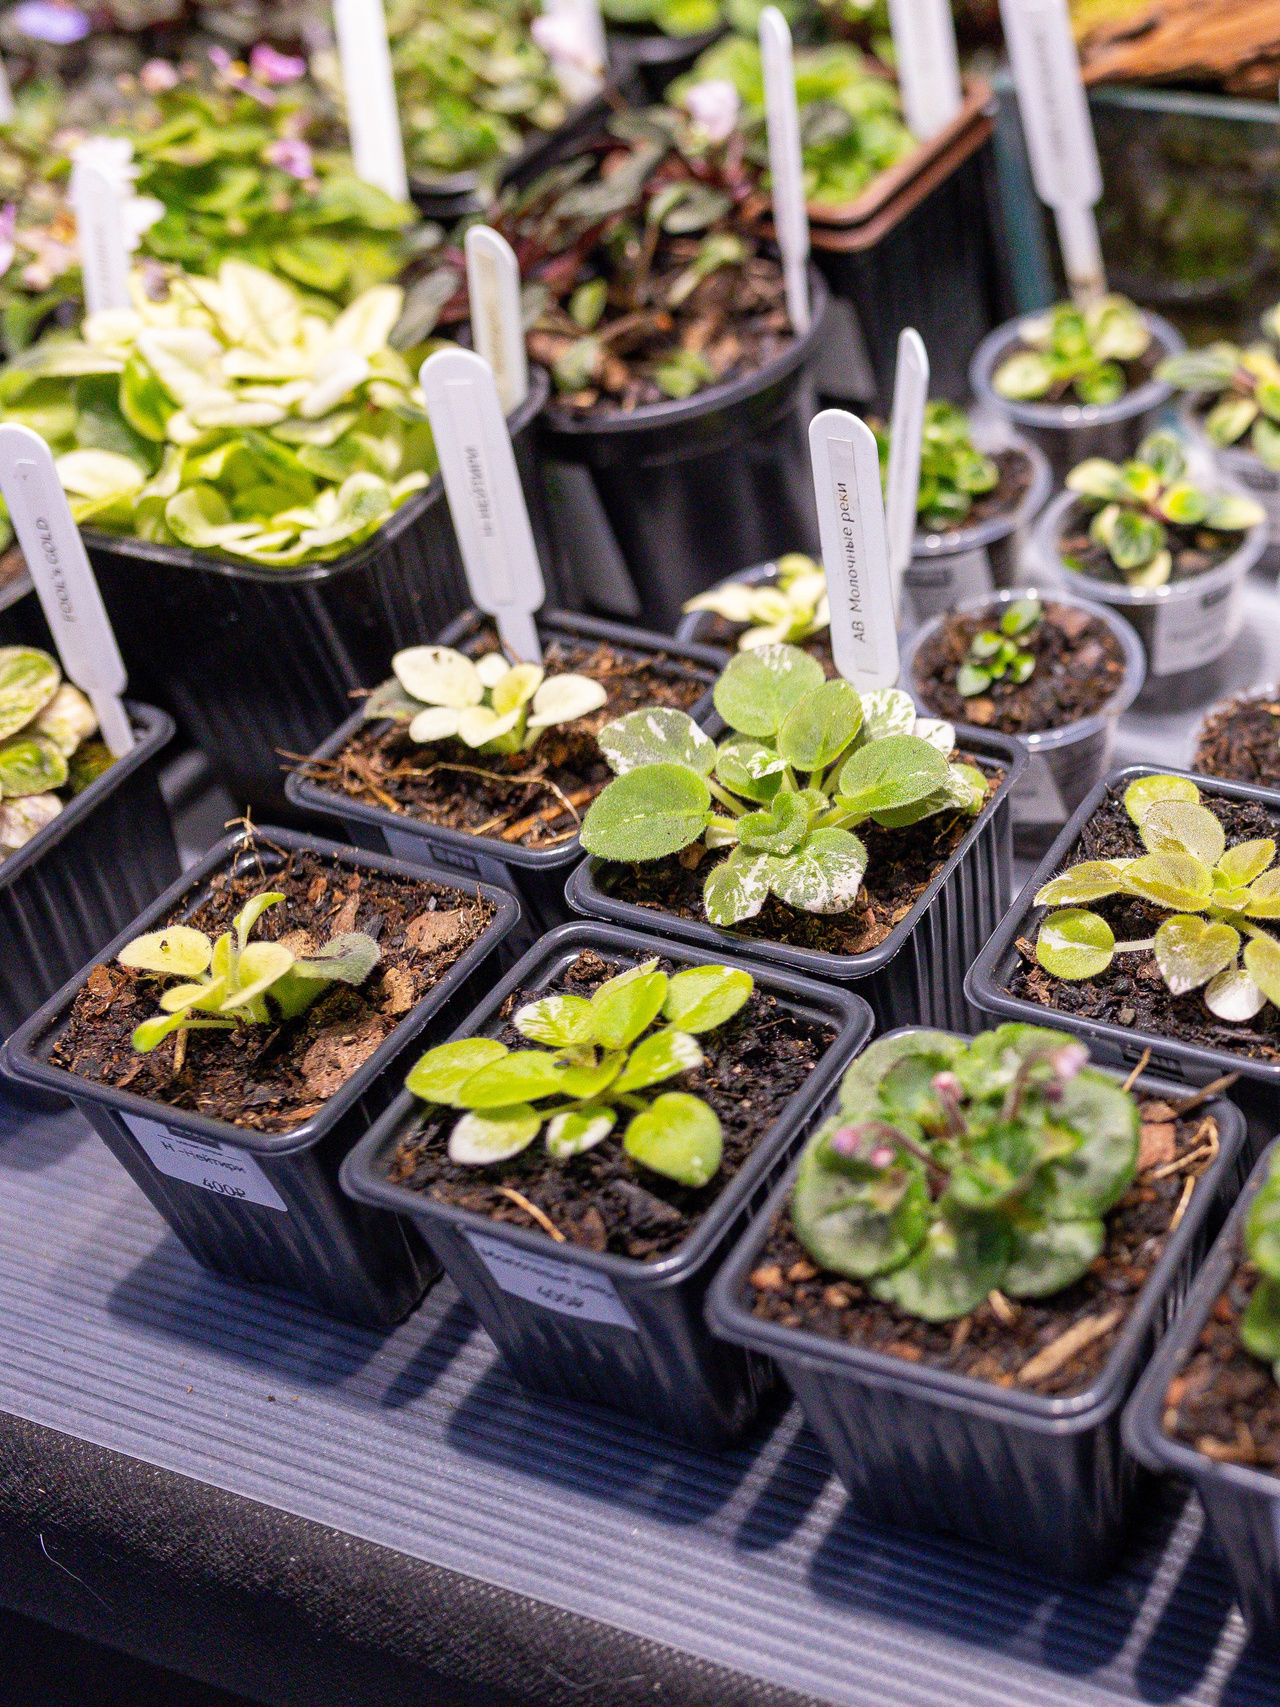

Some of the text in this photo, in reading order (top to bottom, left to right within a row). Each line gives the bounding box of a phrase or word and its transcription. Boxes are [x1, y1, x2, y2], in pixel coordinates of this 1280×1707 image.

[35, 517, 58, 565] GOLD
[837, 481, 867, 644] АВ Молочные реки
